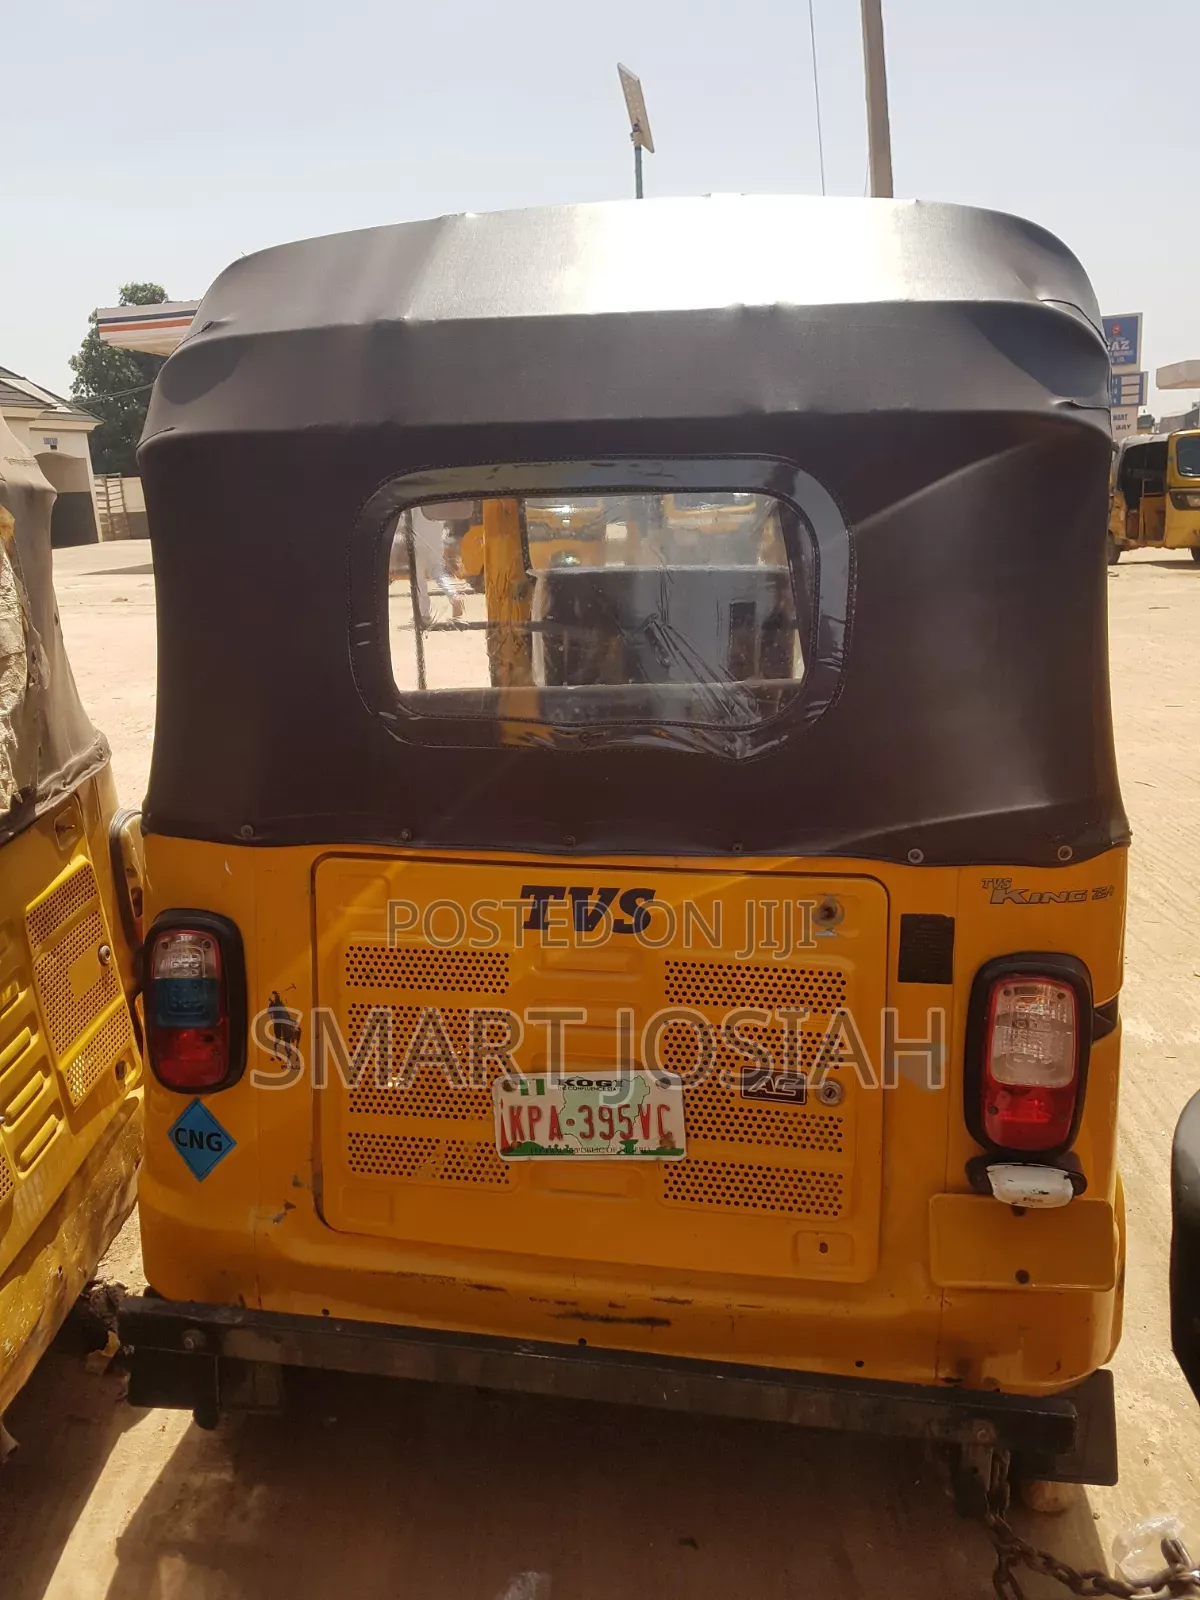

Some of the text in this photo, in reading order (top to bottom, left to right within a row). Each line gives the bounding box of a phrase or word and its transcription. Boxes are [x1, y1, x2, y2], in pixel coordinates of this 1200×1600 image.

[982, 878, 1012, 889] TVS
[520, 885, 657, 934] TVS
[557, 1078, 625, 1087] KOGI
[747, 1076, 801, 1096] AC
[509, 1104, 564, 1142] KPA
[174, 1127, 223, 1152] CNG
